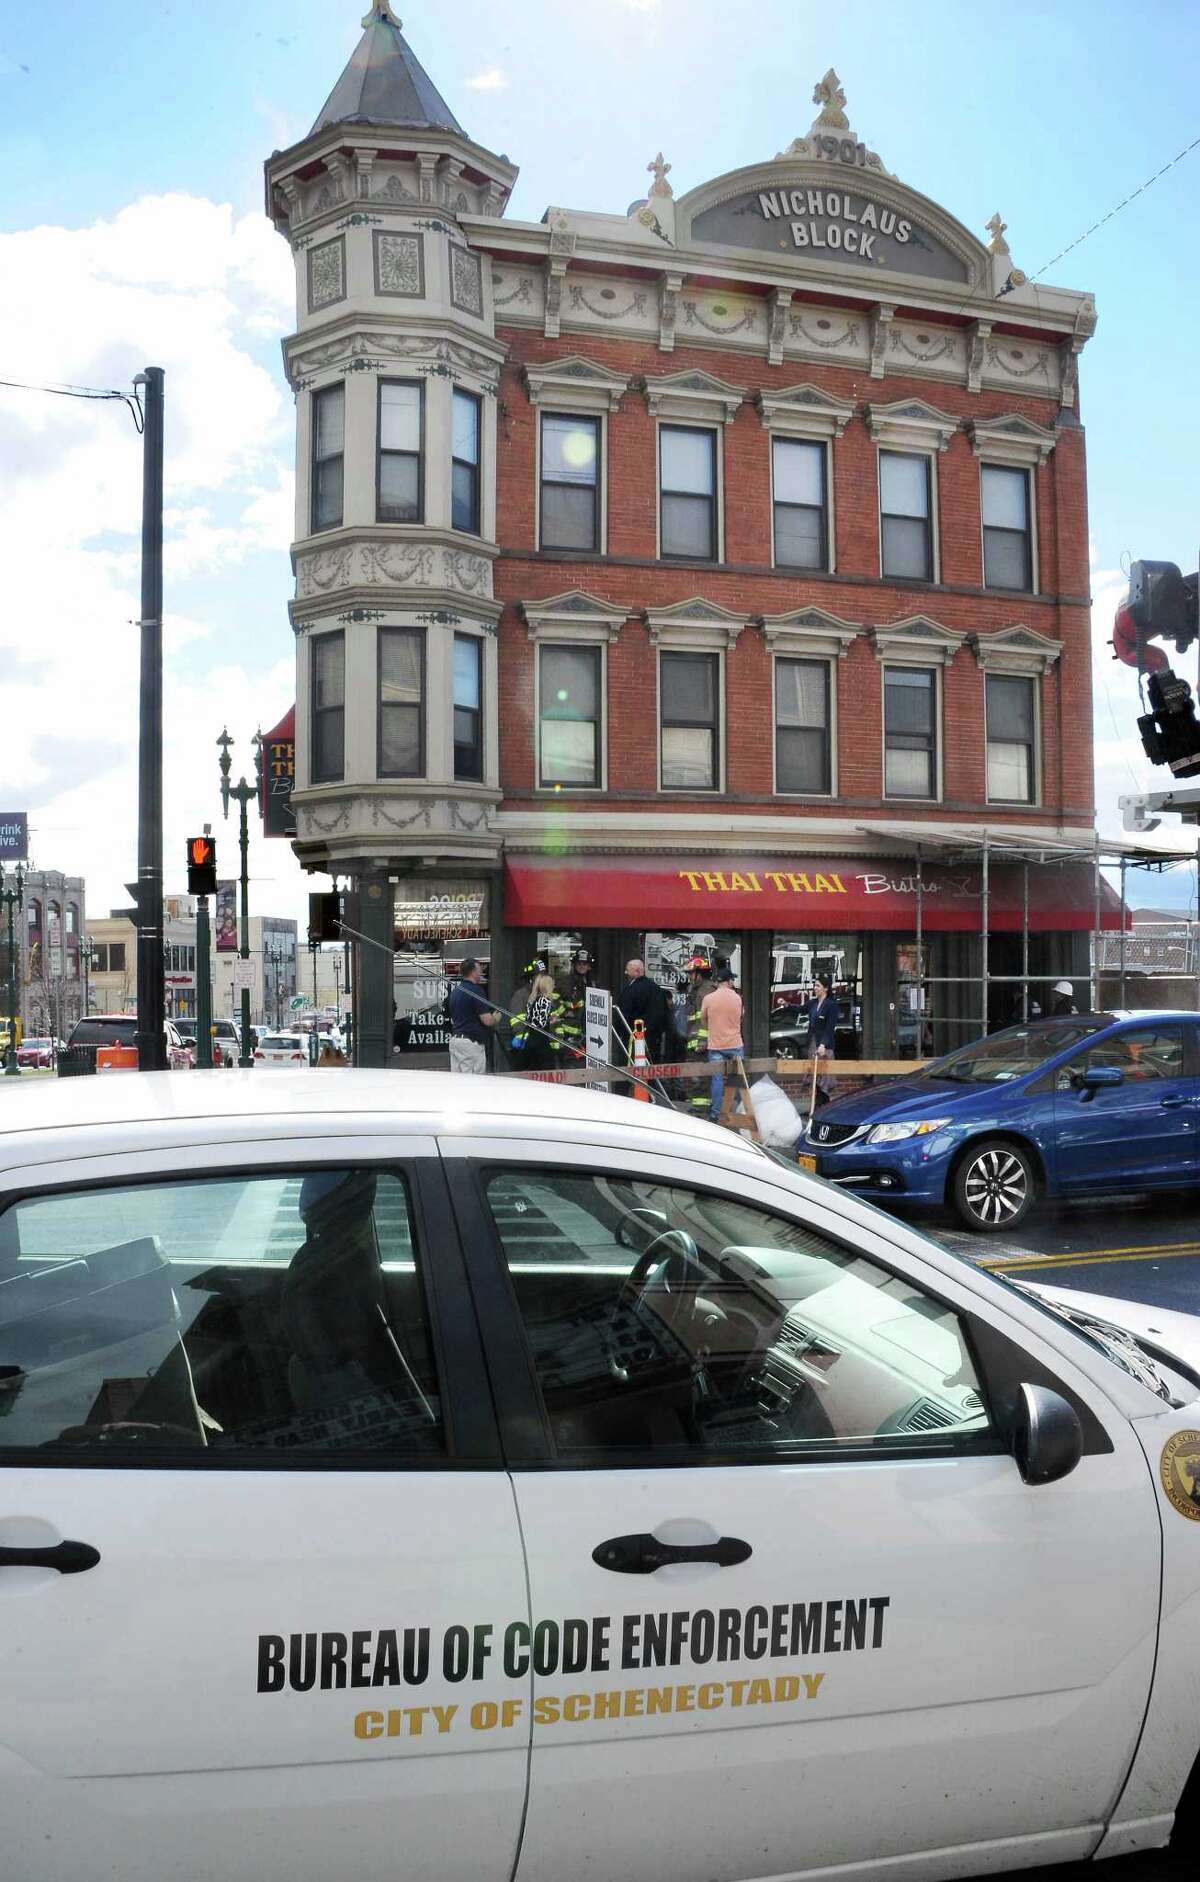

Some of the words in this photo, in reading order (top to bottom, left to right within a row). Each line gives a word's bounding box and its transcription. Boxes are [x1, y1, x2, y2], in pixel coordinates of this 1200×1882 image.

[813, 133, 866, 166] 1901
[758, 190, 913, 244] NICHOLAUS
[791, 222, 876, 260] BLOCK
[680, 871, 763, 893] THAI
[765, 871, 848, 894] THAI
[856, 873, 941, 895] Bistro
[257, 1627, 431, 1693] BUREAU
[443, 1624, 494, 1681] OF
[503, 1616, 610, 1676] CODE
[622, 1596, 890, 1670] ENFORCEMENT
[353, 1703, 459, 1740] CITY
[470, 1700, 523, 1731] OF
[533, 1672, 827, 1725] SCHENECTADY
